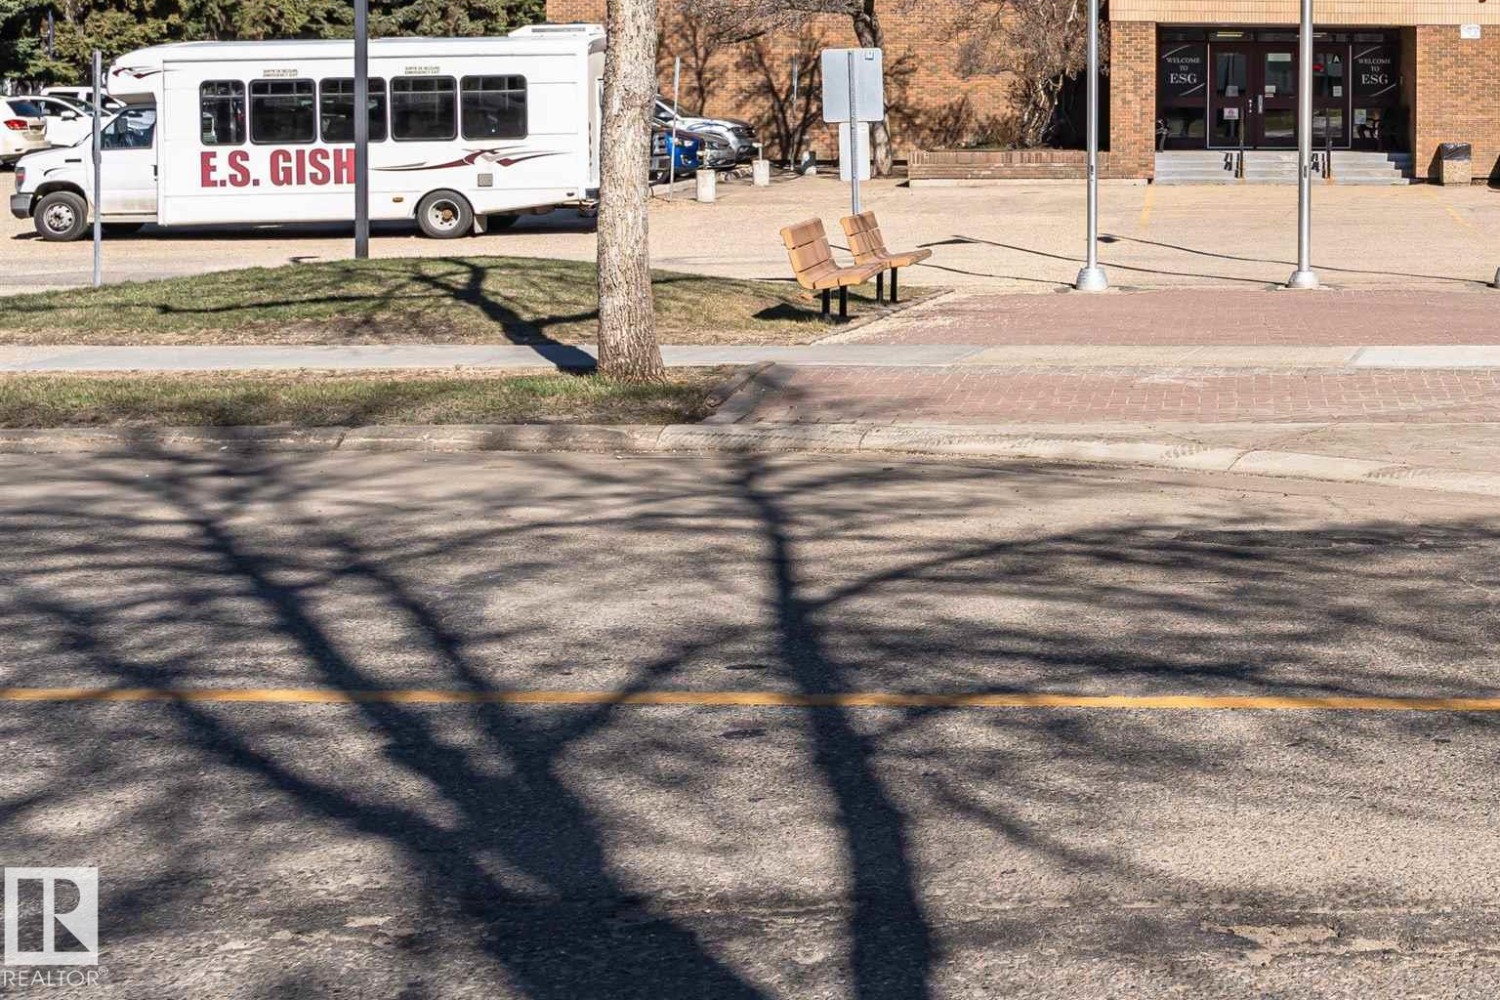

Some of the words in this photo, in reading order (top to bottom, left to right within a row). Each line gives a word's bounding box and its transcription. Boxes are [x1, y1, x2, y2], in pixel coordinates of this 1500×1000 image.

[1170, 73, 1197, 84] ESG
[1361, 73, 1388, 84] ESG
[200, 150, 260, 188] E.S.
[269, 148, 356, 186] GISH
